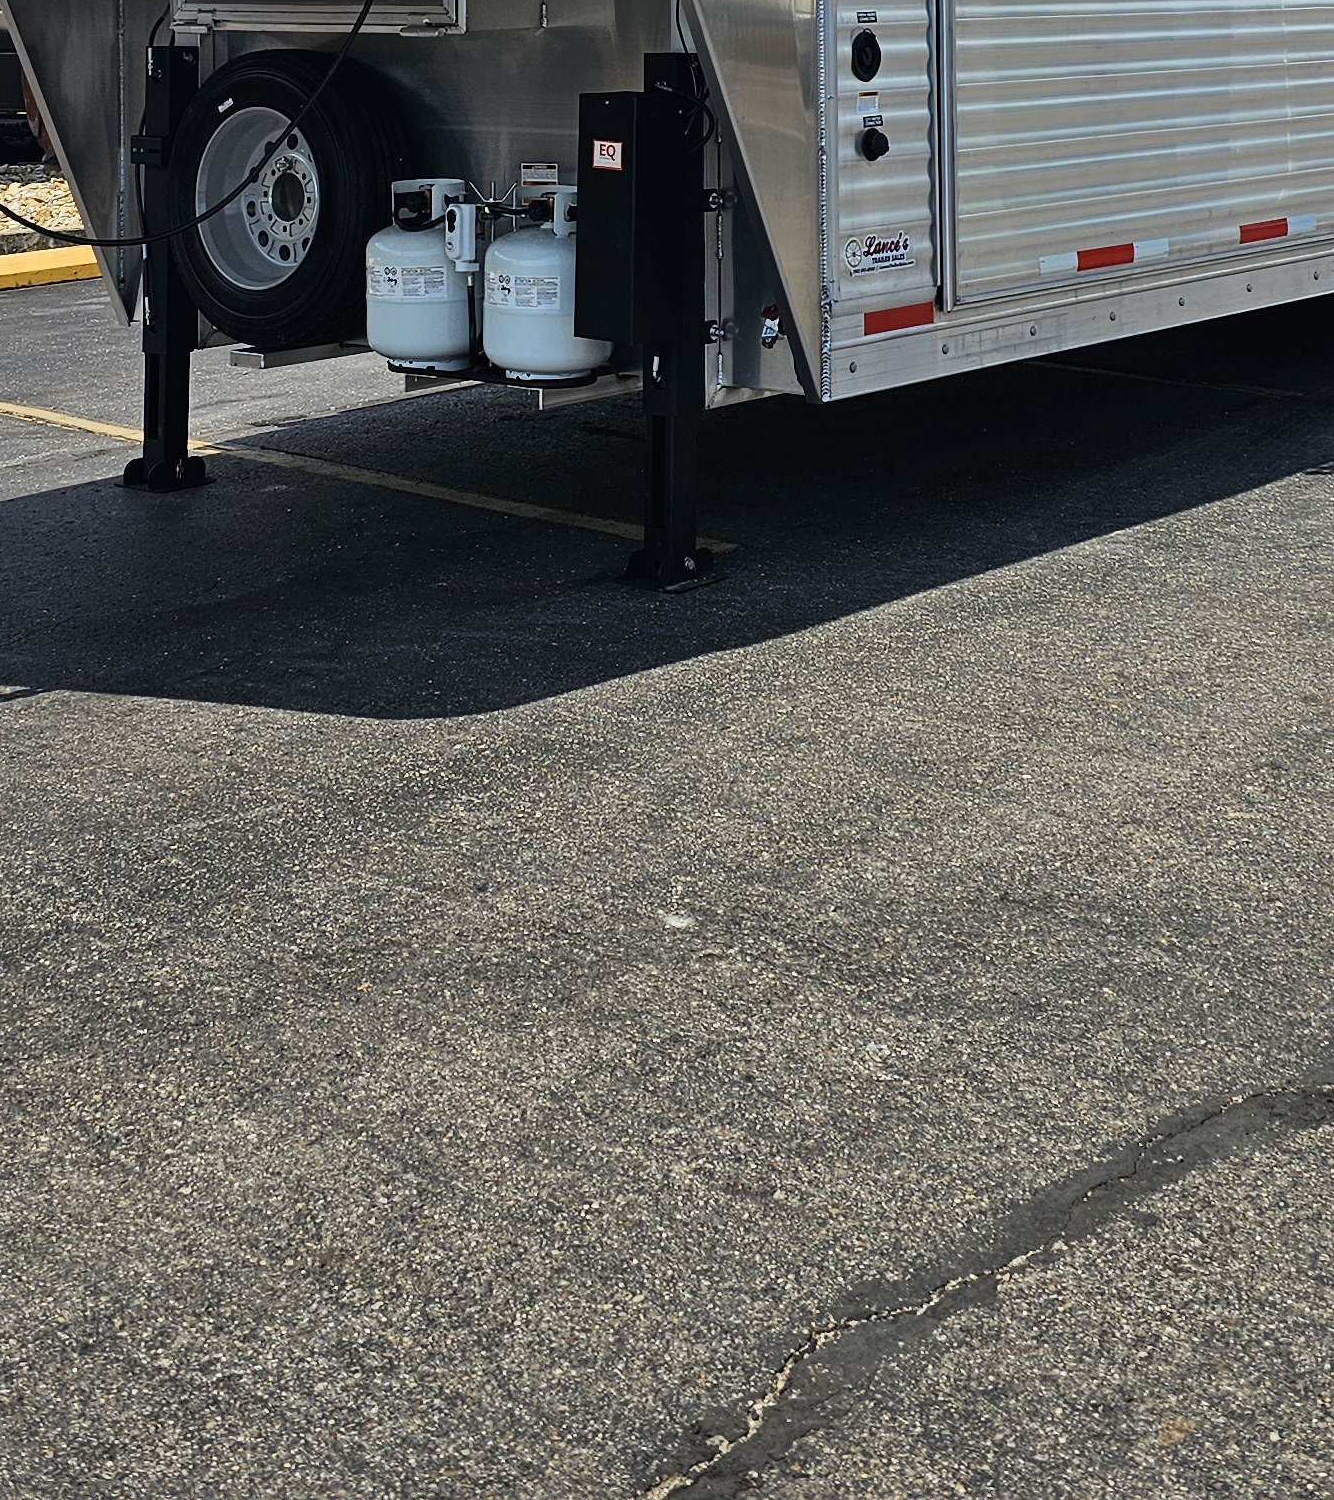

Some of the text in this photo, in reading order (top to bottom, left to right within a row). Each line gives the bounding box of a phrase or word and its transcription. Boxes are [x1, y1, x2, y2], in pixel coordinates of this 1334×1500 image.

[599, 143, 616, 162] EQ
[872, 252, 906, 265] TRAILER SALES
